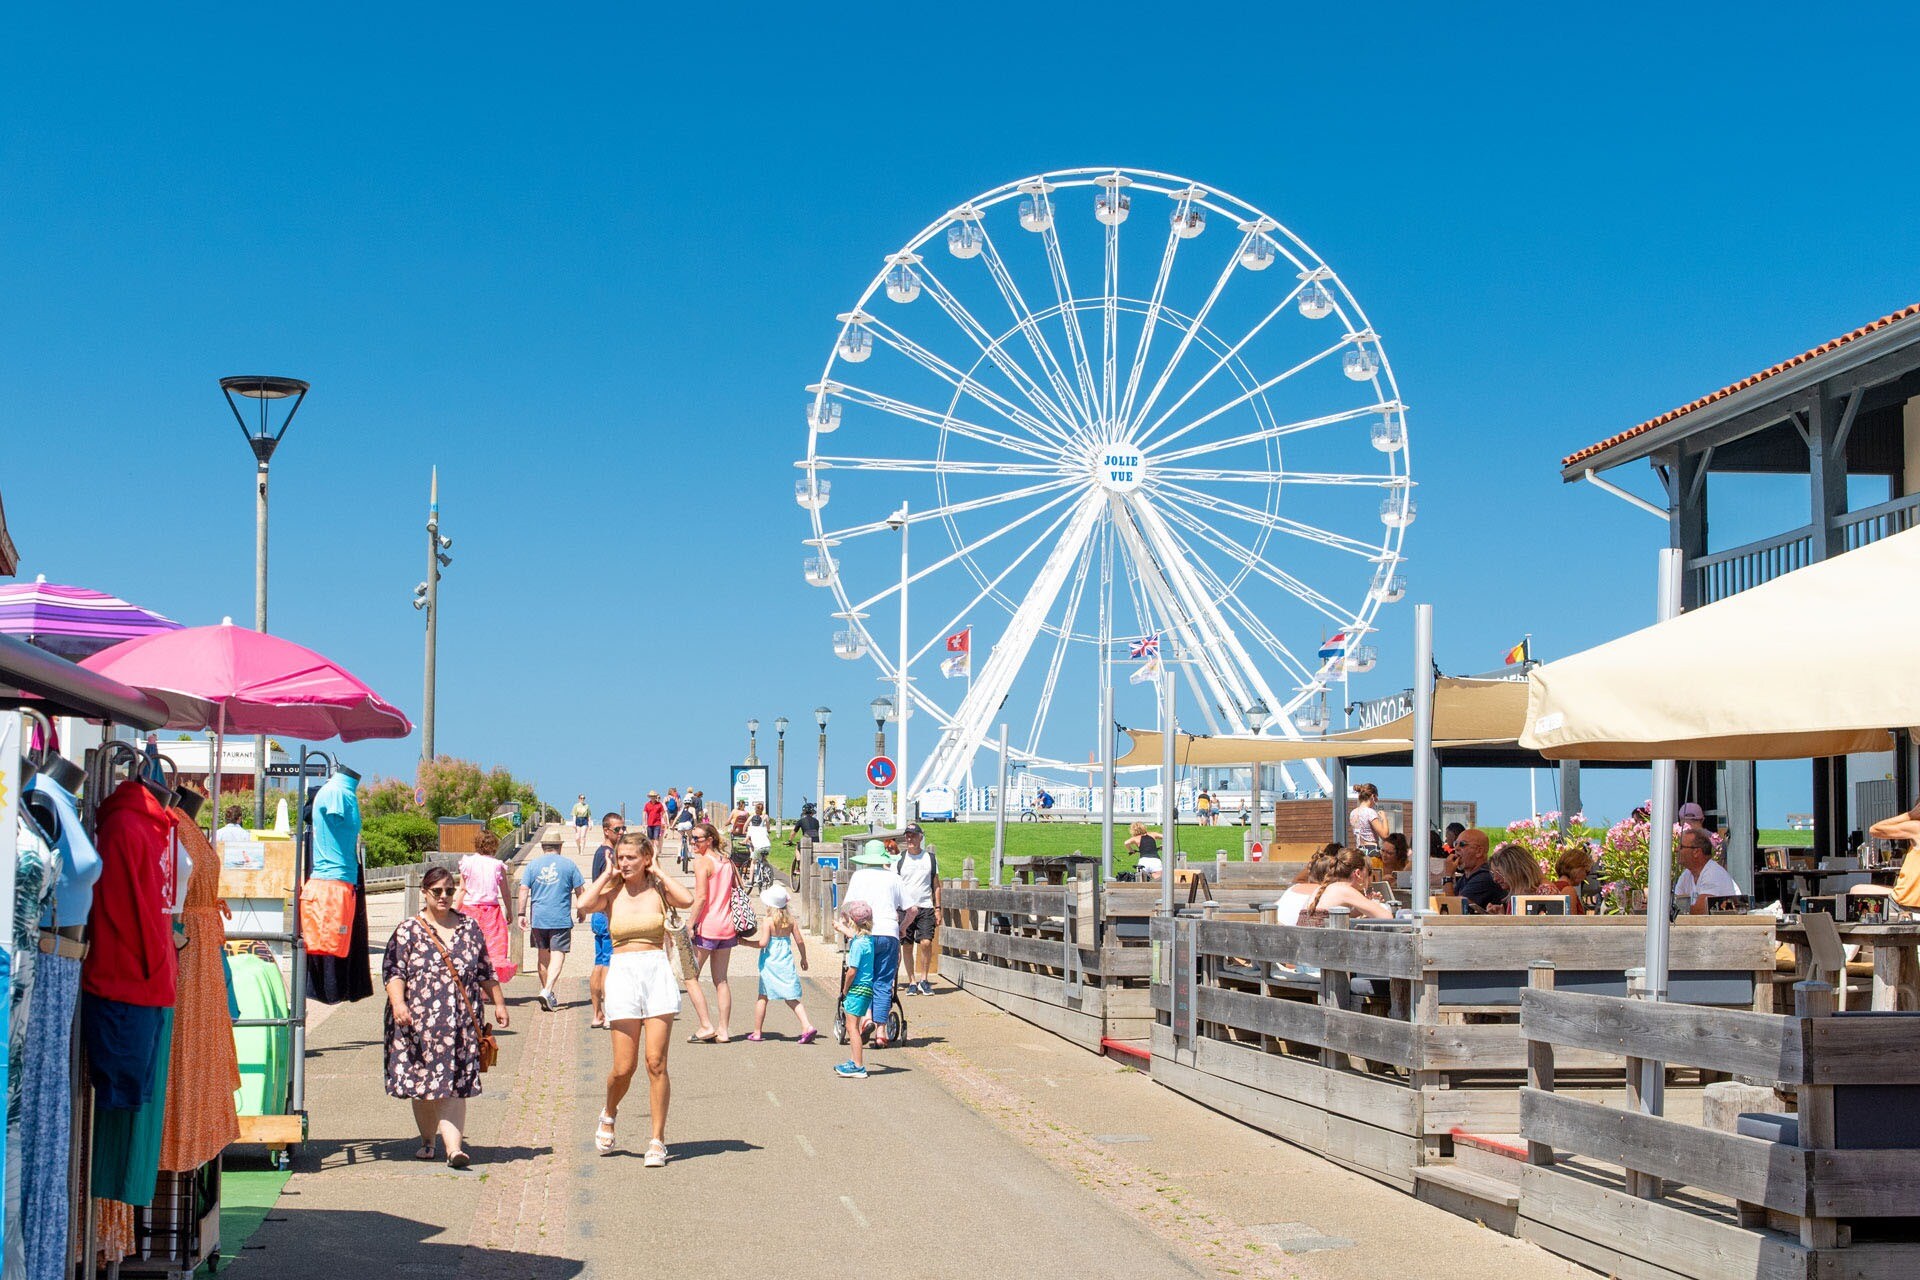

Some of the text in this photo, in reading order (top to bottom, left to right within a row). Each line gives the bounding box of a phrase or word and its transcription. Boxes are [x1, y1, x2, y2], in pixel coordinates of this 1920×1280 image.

[1104, 455, 1138, 467] JOLIE
[1111, 471, 1133, 482] VUE
[1359, 698, 1396, 731] SANGO
